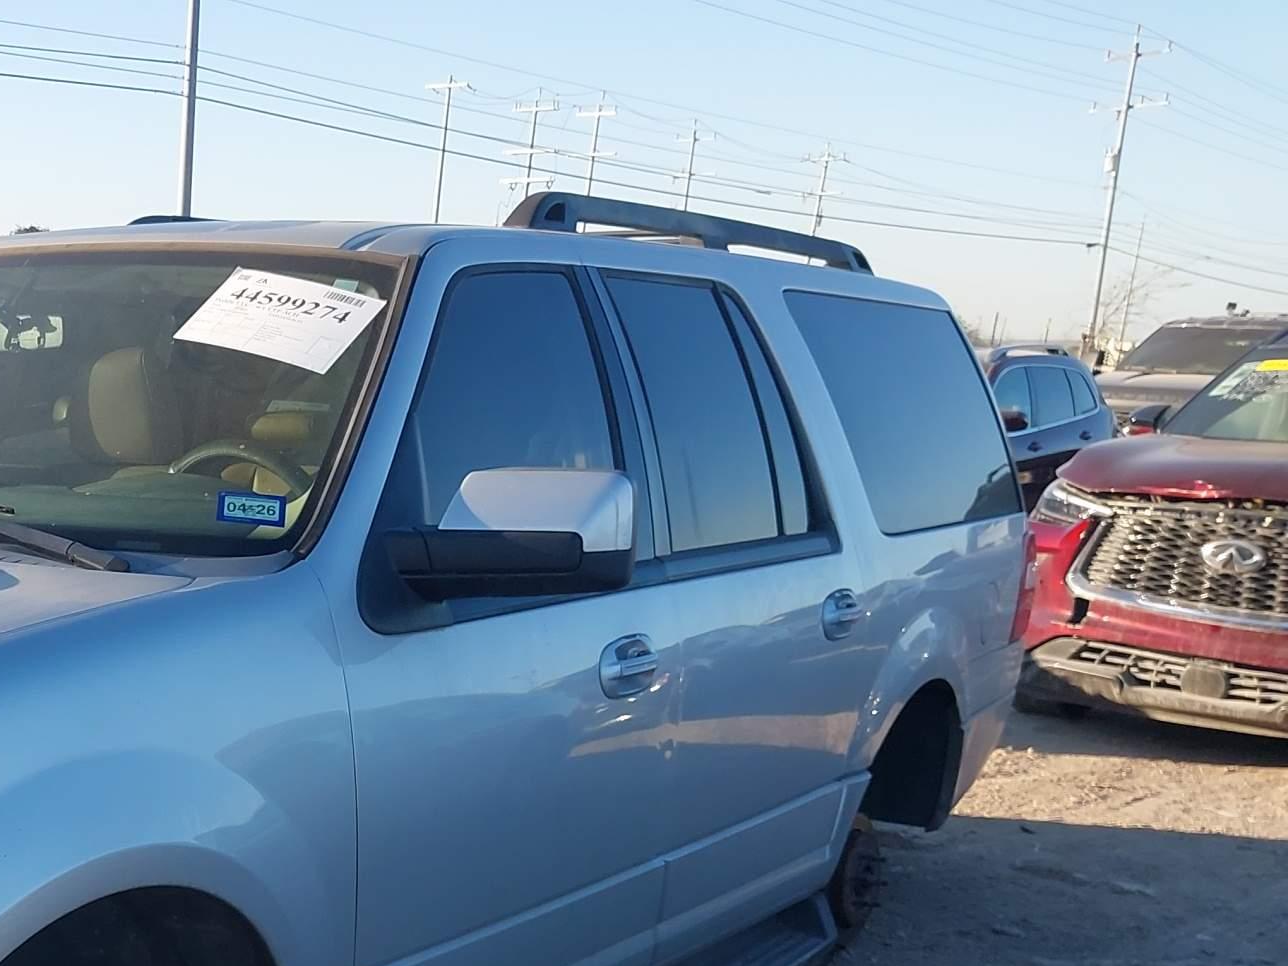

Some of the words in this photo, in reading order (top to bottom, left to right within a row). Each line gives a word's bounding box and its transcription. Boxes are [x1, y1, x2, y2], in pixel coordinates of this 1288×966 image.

[230, 287, 352, 324] 44599274
[227, 502, 246, 513] 04
[256, 504, 276, 516] 26
